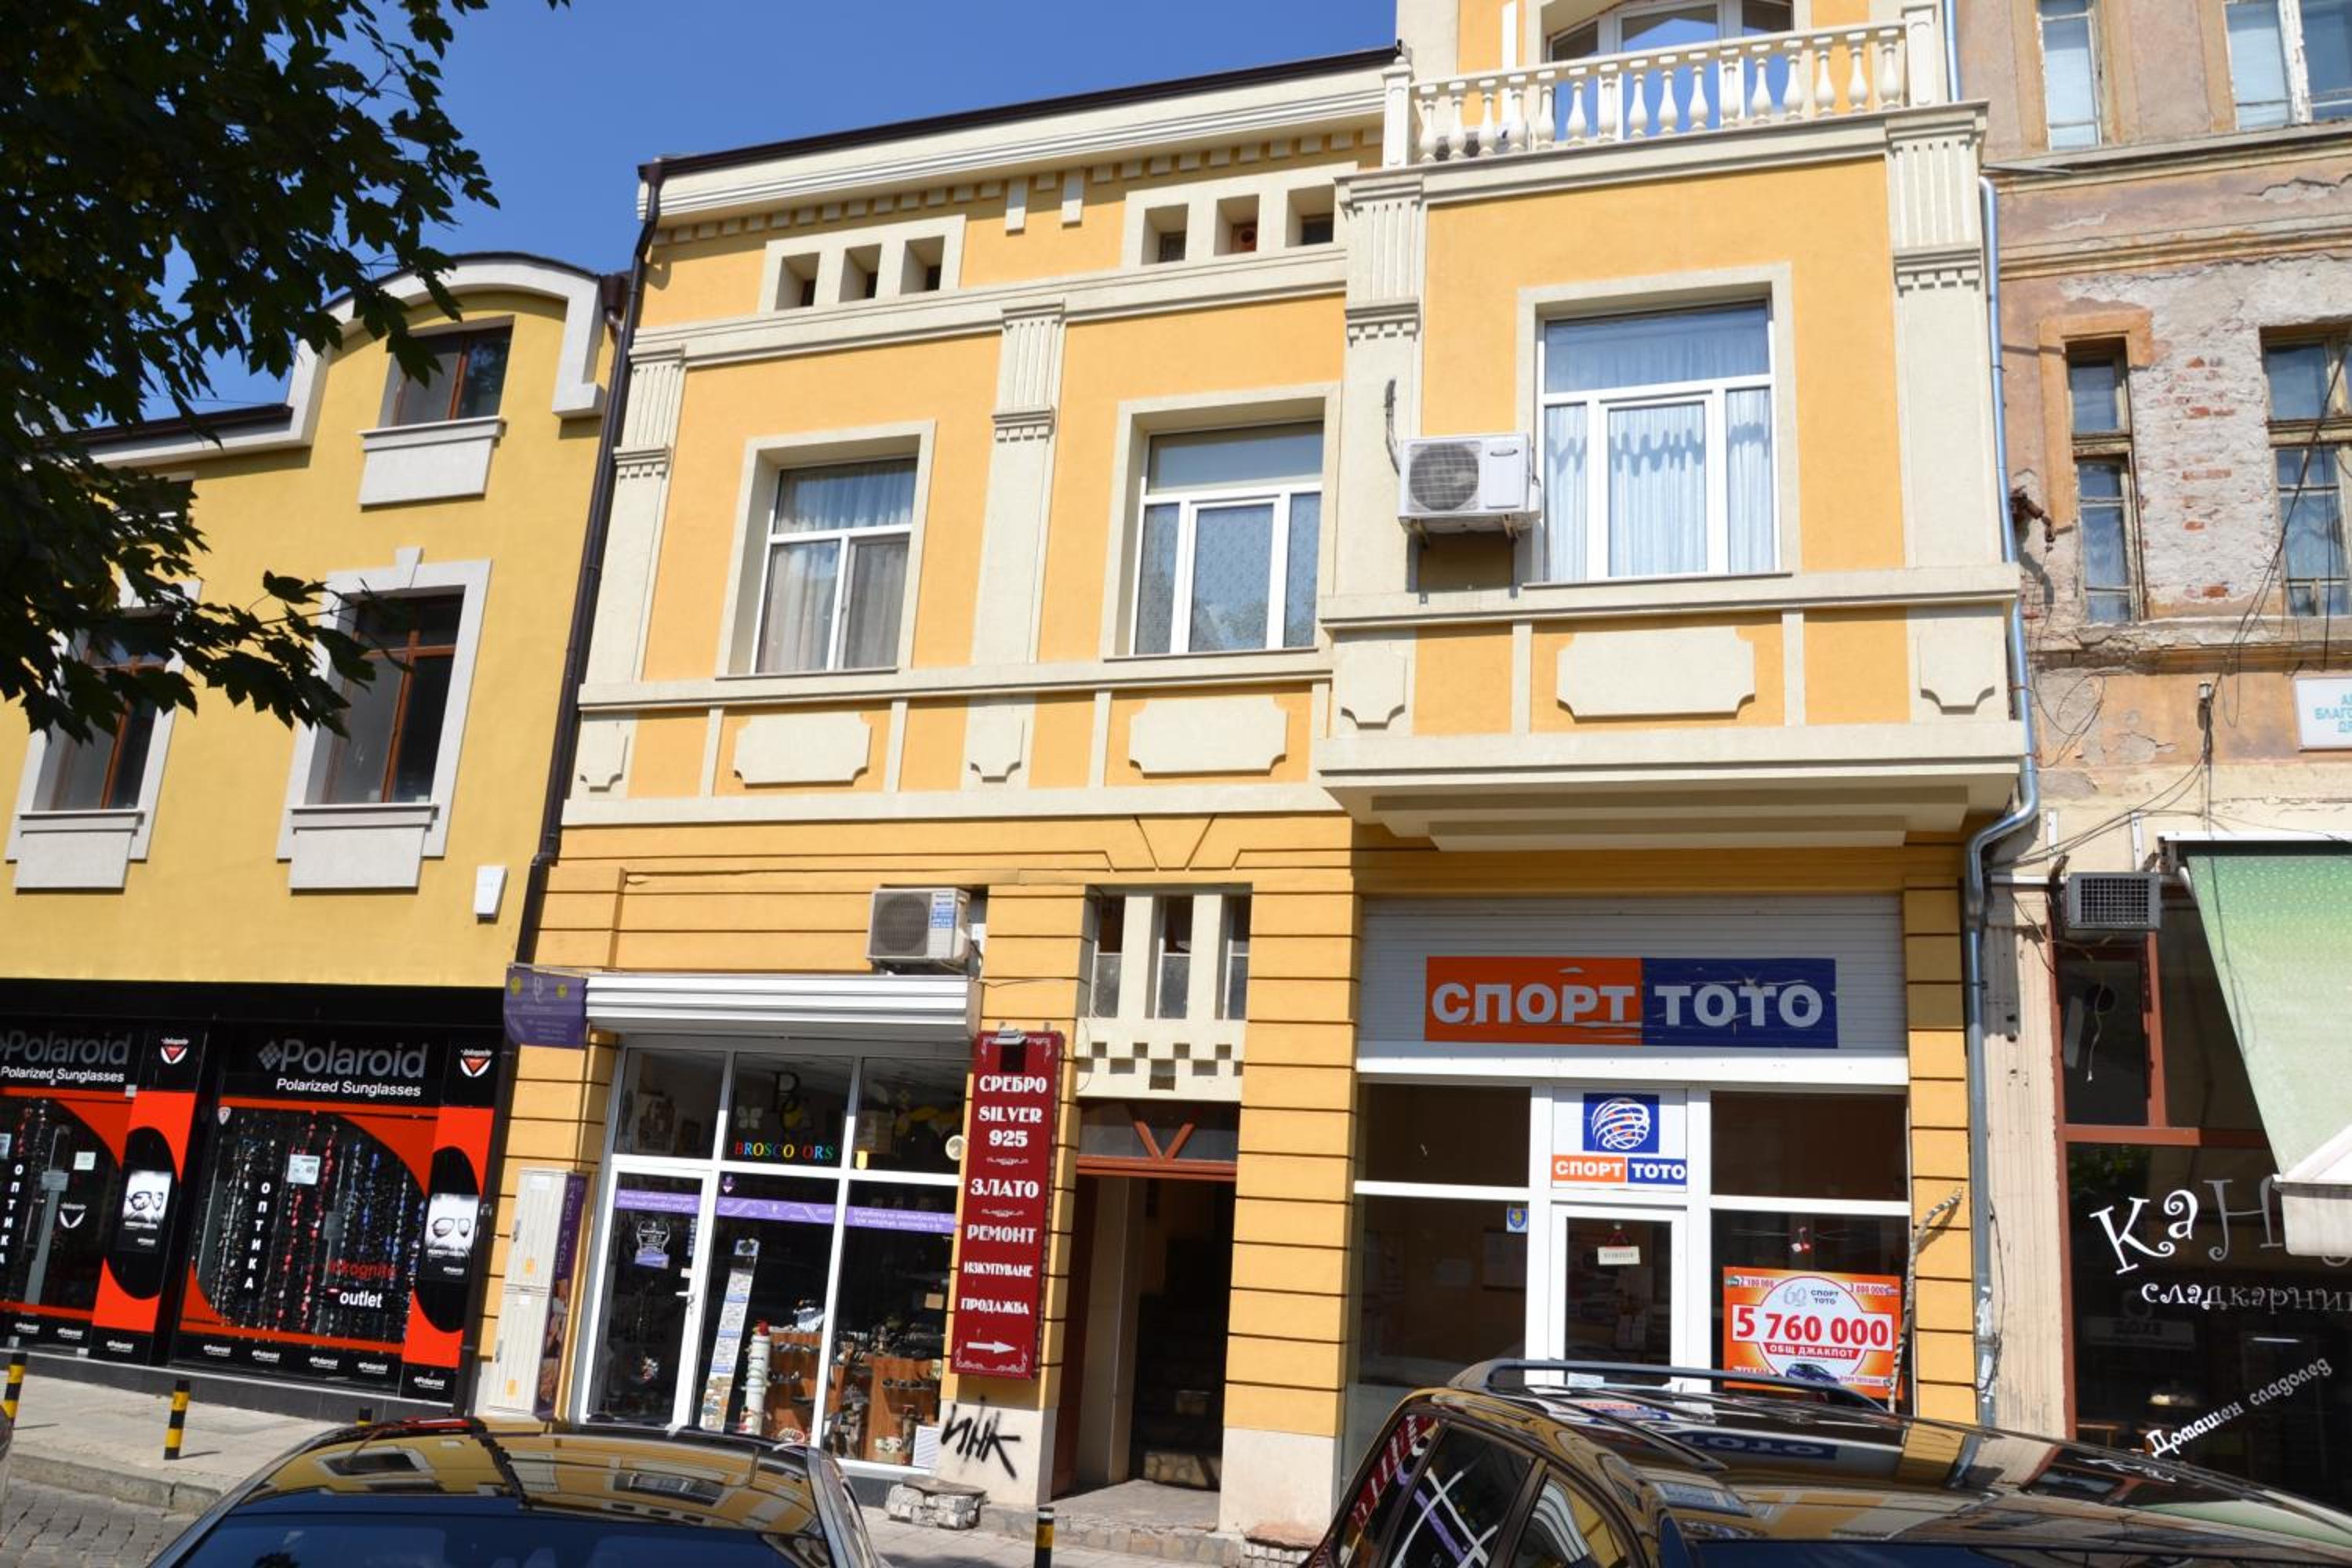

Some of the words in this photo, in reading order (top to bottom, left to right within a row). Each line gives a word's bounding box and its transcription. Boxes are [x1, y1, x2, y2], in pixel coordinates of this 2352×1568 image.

[1432, 983, 1635, 1024] СПОРТ
[1655, 985, 1823, 1027] ТОТО
[4, 1030, 132, 1066] Polaroid
[279, 1039, 429, 1078] Polaroid
[0, 1066, 53, 1079] Polarized
[56, 1068, 125, 1083] Sunglasses
[277, 1078, 338, 1093] Polarized
[342, 1080, 421, 1098] Sunglasses
[979, 1075, 1047, 1094] СРЕБРО
[978, 1106, 1042, 1123] SILVER
[989, 1130, 1029, 1147] 925
[1555, 1160, 1623, 1177] СПОРТ
[1632, 1163, 1686, 1180] ТОТО
[971, 1178, 1039, 1198] ЗЛАТО
[245, 1182, 270, 1289] ОПТИКА
[967, 1224, 1036, 1243] РЕМОНТ
[964, 1261, 1033, 1277] ИЗКУПУВАНЕ
[339, 1290, 383, 1308] outlet
[960, 1298, 1029, 1315] ПРОДАЖБА
[1737, 1308, 1755, 1338] 5
[1766, 1313, 1822, 1342] 760
[1831, 1317, 1889, 1346] 000
[1769, 1345, 1796, 1356] ОБЩ
[1798, 1347, 1853, 1358] ДЖАКПОТ
[2146, 1402, 2245, 1458] Домашен
[2249, 1358, 2332, 1406] сладолед
